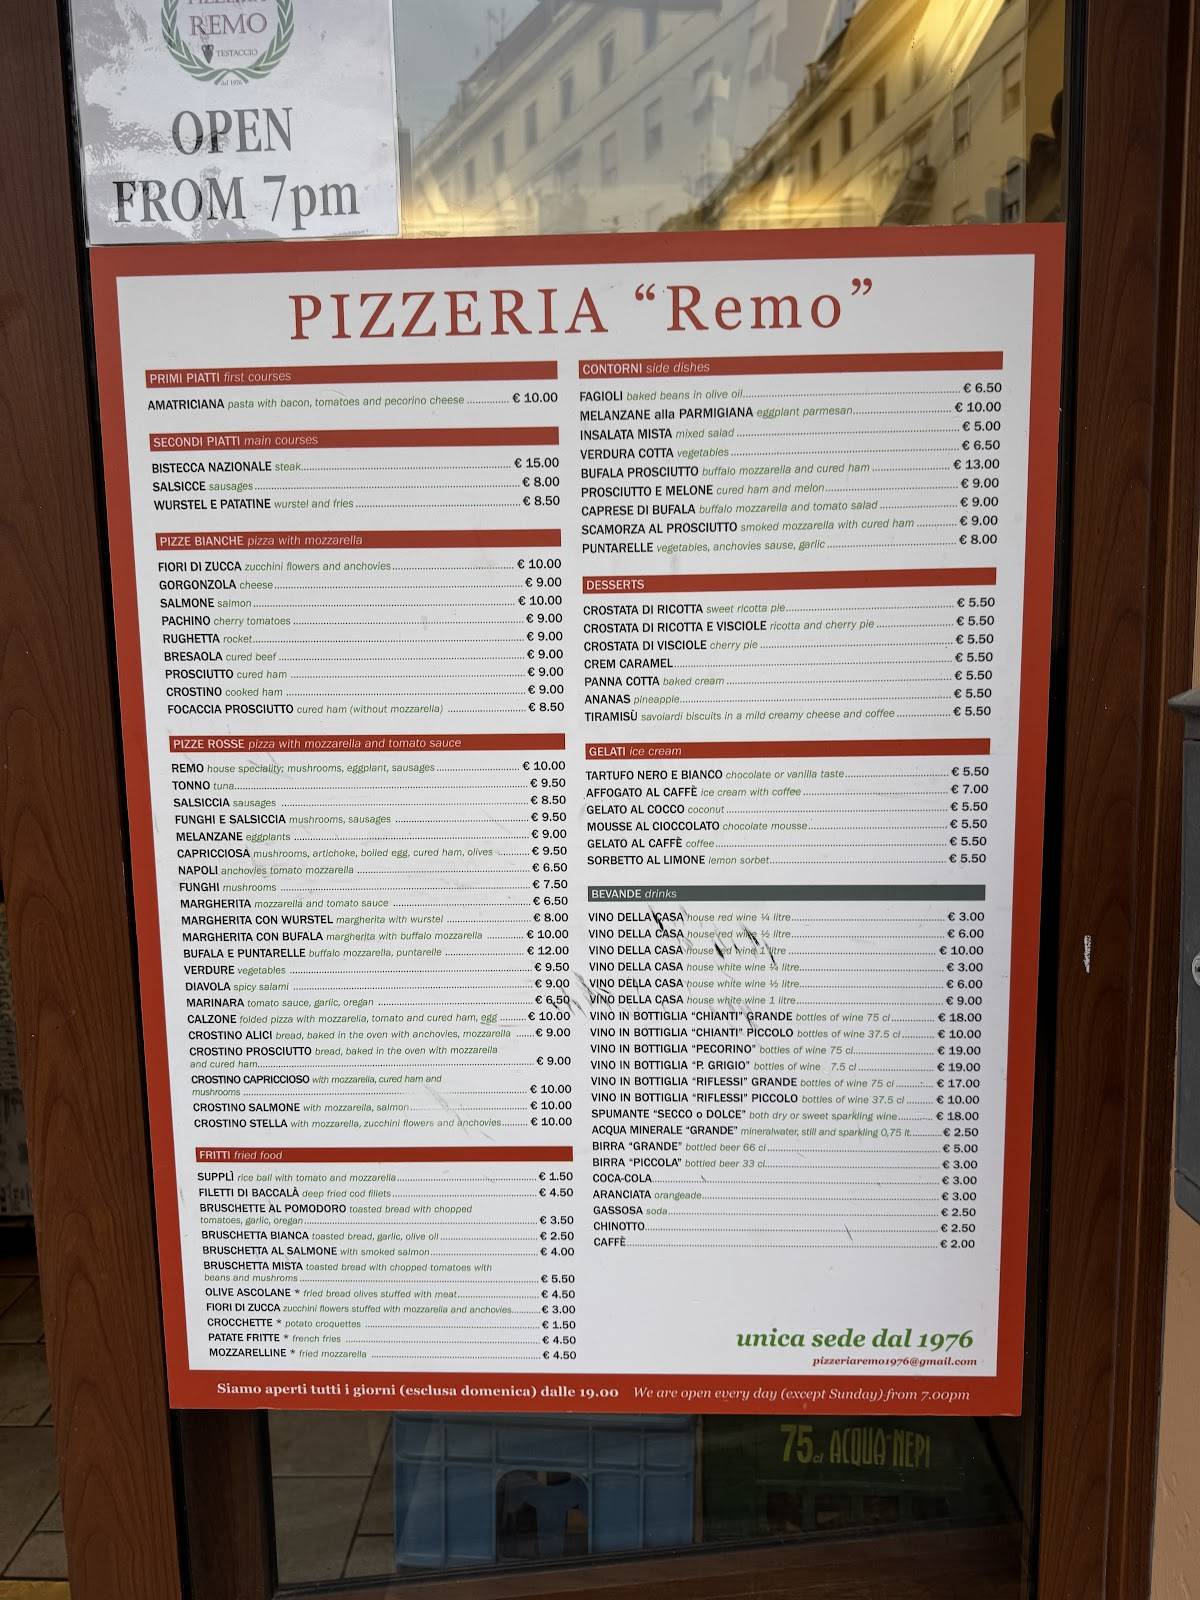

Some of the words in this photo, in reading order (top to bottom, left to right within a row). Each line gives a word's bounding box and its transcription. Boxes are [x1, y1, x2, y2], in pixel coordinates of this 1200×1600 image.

[188, 13, 268, 36] REMO
[216, 49, 258, 57] TESTACCIO
[172, 107, 293, 155] OPEN
[113, 177, 247, 223] FROM
[263, 175, 361, 231] 7pm
[289, 287, 608, 340] PIZZERIA
[582, 362, 642, 375] CONTORNI
[646, 362, 669, 374] side
[673, 361, 710, 373] dishes
[149, 372, 182, 384] PRIMI
[186, 371, 220, 383] PIATTI
[223, 372, 244, 382] first
[247, 372, 291, 382] courses
[579, 389, 623, 402] FAGIOLI
[626, 391, 657, 401] baked
[659, 391, 690, 400] beans
[693, 390, 702, 399] in
[705, 389, 728, 399] olive
[731, 389, 745, 398] oil
[962, 382, 971, 394] €
[974, 381, 1002, 393] 6.50
[147, 398, 225, 411] AMATRICIANA
[227, 399, 254, 410] pasta
[257, 398, 277, 408] with
[280, 399, 312, 408] bacon,
[315, 398, 360, 407] tomatoes
[362, 396, 382, 406] and
[384, 395, 427, 407] pecorino
[429, 395, 464, 405] cheese
[511, 392, 520, 403] €
[523, 391, 558, 403] 10.00
[153, 436, 203, 448] SECONDI
[206, 435, 240, 447] PIATTI
[244, 435, 271, 446] main
[274, 435, 318, 445] courses
[151, 461, 205, 474] BISTECCA
[208, 460, 272, 473] NAZIONALE
[274, 463, 300, 471] steak
[513, 457, 522, 469] €
[525, 456, 559, 469] 15.00
[159, 535, 191, 547] PIZZE
[194, 535, 244, 546] BIANCHE
[247, 535, 274, 548] pizza
[278, 535, 300, 545] with
[304, 535, 362, 545] mozzarella
[586, 578, 644, 590] DESSERTS
[163, 650, 223, 662] BRESAOLA
[225, 652, 252, 661] cured
[255, 653, 276, 661] beef
[526, 648, 535, 660] €
[537, 648, 564, 659] 9.00
[173, 738, 204, 749] PIZZE
[207, 738, 245, 749] ROSSE
[248, 738, 275, 751] pizza
[278, 738, 300, 749] with
[304, 738, 361, 749] mozzarella
[364, 738, 385, 748] and
[388, 738, 426, 748] tomato
[429, 739, 461, 748] sauce
[588, 746, 625, 757] GELATI
[629, 746, 645, 756] ice
[647, 747, 681, 756] cream
[586, 804, 627, 815] GELATO
[629, 804, 644, 814] AL
[646, 803, 685, 814] COCCO
[687, 805, 724, 814] coconut
[949, 801, 958, 812] €
[961, 800, 988, 812] 5.50
[175, 831, 243, 842] MELANZANE
[245, 832, 290, 843] eggplants
[530, 828, 539, 839] €
[541, 828, 567, 839] 9.00
[586, 854, 644, 865] SORBETTO
[646, 855, 660, 865] AL
[663, 854, 705, 865] LIMONE
[708, 857, 736, 865] lemon
[739, 856, 771, 864] sorbet
[948, 852, 957, 864] €
[959, 852, 987, 864] 5.50
[591, 888, 641, 899] BEVANDE
[644, 888, 677, 899] drinks
[183, 964, 235, 975] VERDURE
[237, 965, 286, 976] vegetables
[533, 961, 542, 972] €
[544, 961, 570, 972] 9.50
[589, 1043, 616, 1054] VINO
[619, 1043, 630, 1053] IN
[633, 1043, 688, 1054] BOTTIGLIA
[759, 1046, 790, 1054] bottles
[793, 1046, 802, 1054] of
[805, 1046, 826, 1054] wine
[830, 1045, 842, 1054] 75
[936, 1045, 945, 1055] €
[948, 1045, 981, 1056] 19.00
[197, 1149, 231, 1160] FRITTI
[233, 1149, 257, 1160] fried
[260, 1150, 282, 1160] food
[592, 1173, 654, 1183] COCA-COLA
[941, 1175, 949, 1185] €
[952, 1175, 977, 1185] 3.00
[198, 1187, 234, 1197] FILETTI
[236, 1187, 248, 1198] DI
[251, 1185, 300, 1198] BACCALÀ
[301, 1190, 324, 1199] deep
[326, 1189, 347, 1198] fried
[349, 1189, 365, 1198] cod
[368, 1189, 391, 1198] fillets
[538, 1187, 546, 1197] €
[549, 1187, 574, 1197] 4.50
[593, 1235, 626, 1247] CAFFÈ
[939, 1238, 948, 1249] €
[950, 1238, 975, 1249] 2.00
[202, 1245, 269, 1255] BRUSCHETTA
[270, 1245, 284, 1255] AL
[286, 1245, 337, 1256] SALMONE
[340, 1247, 358, 1255] with
[360, 1248, 395, 1256] smoked
[397, 1248, 432, 1256] salmon
[539, 1246, 547, 1256] €
[550, 1246, 575, 1257] 4.00
[737, 1328, 804, 1346] unica
[811, 1328, 865, 1347] sede
[871, 1328, 911, 1347] dal
[917, 1330, 973, 1351] 1976
[811, 1355, 977, 1368] pizzeriaremo1976@gmail.com
[216, 1382, 262, 1394] Siamo
[264, 1383, 307, 1397] aperti
[310, 1383, 341, 1395] tutti
[352, 1383, 395, 1398] giorni
[399, 1384, 457, 1397] (esclusa
[460, 1384, 537, 1398] domenica)
[540, 1385, 574, 1397] dalle
[580, 1388, 619, 1399] 19.00
[634, 1386, 653, 1398] We
[656, 1389, 678, 1398] are
[680, 1389, 711, 1401] open
[714, 1389, 750, 1401] every
[752, 1386, 777, 1401] day
[780, 1387, 826, 1402] (except
[920, 1390, 970, 1403] 7.00pm
[780, 1424, 813, 1463] 75
